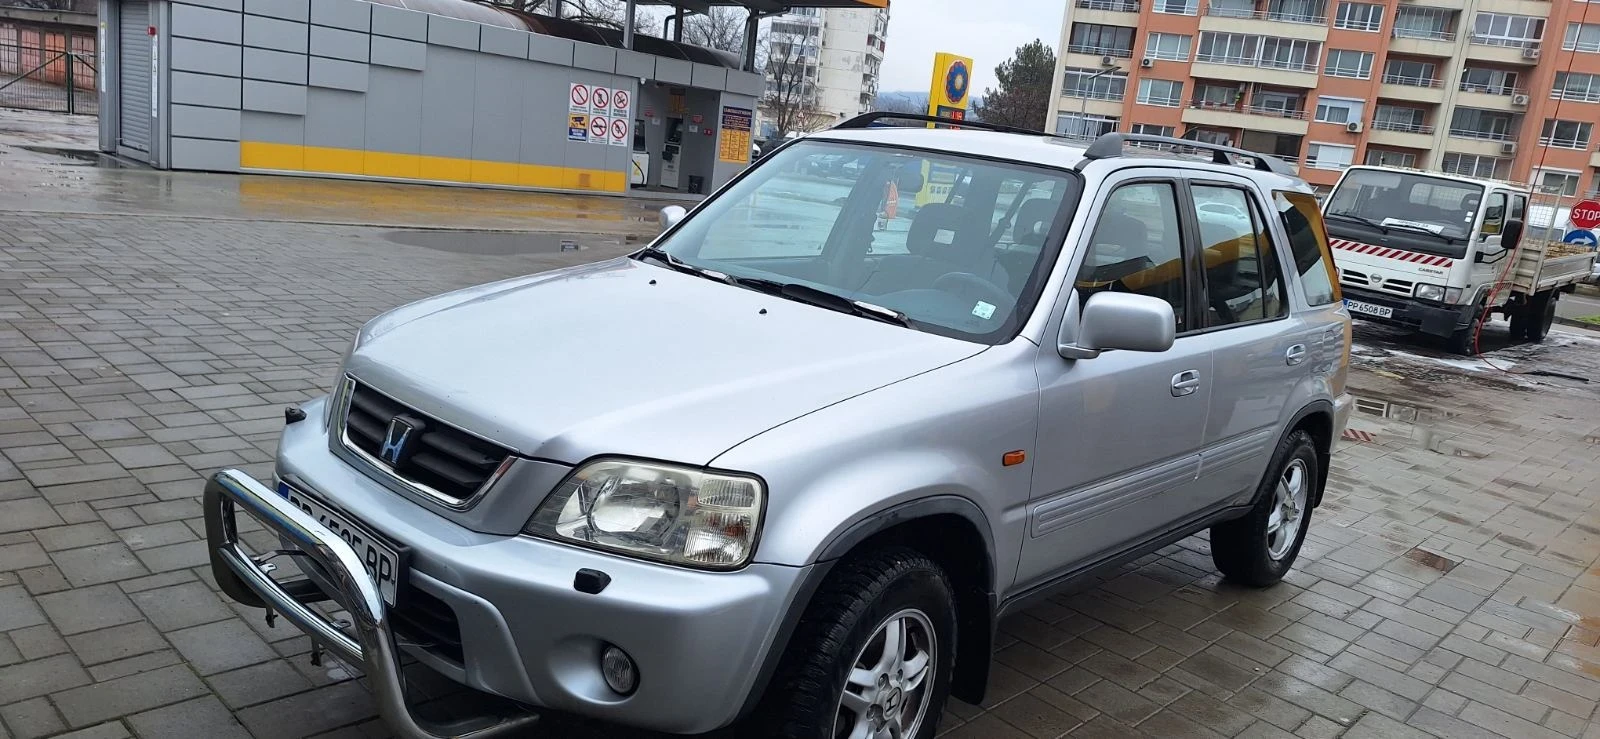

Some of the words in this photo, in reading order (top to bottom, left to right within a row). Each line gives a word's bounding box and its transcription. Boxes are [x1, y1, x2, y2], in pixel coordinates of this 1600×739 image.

[1572, 208, 1600, 221] STOP
[1347, 301, 1359, 309] PP
[1359, 304, 1379, 315] 6508
[1379, 307, 1391, 316] BP
